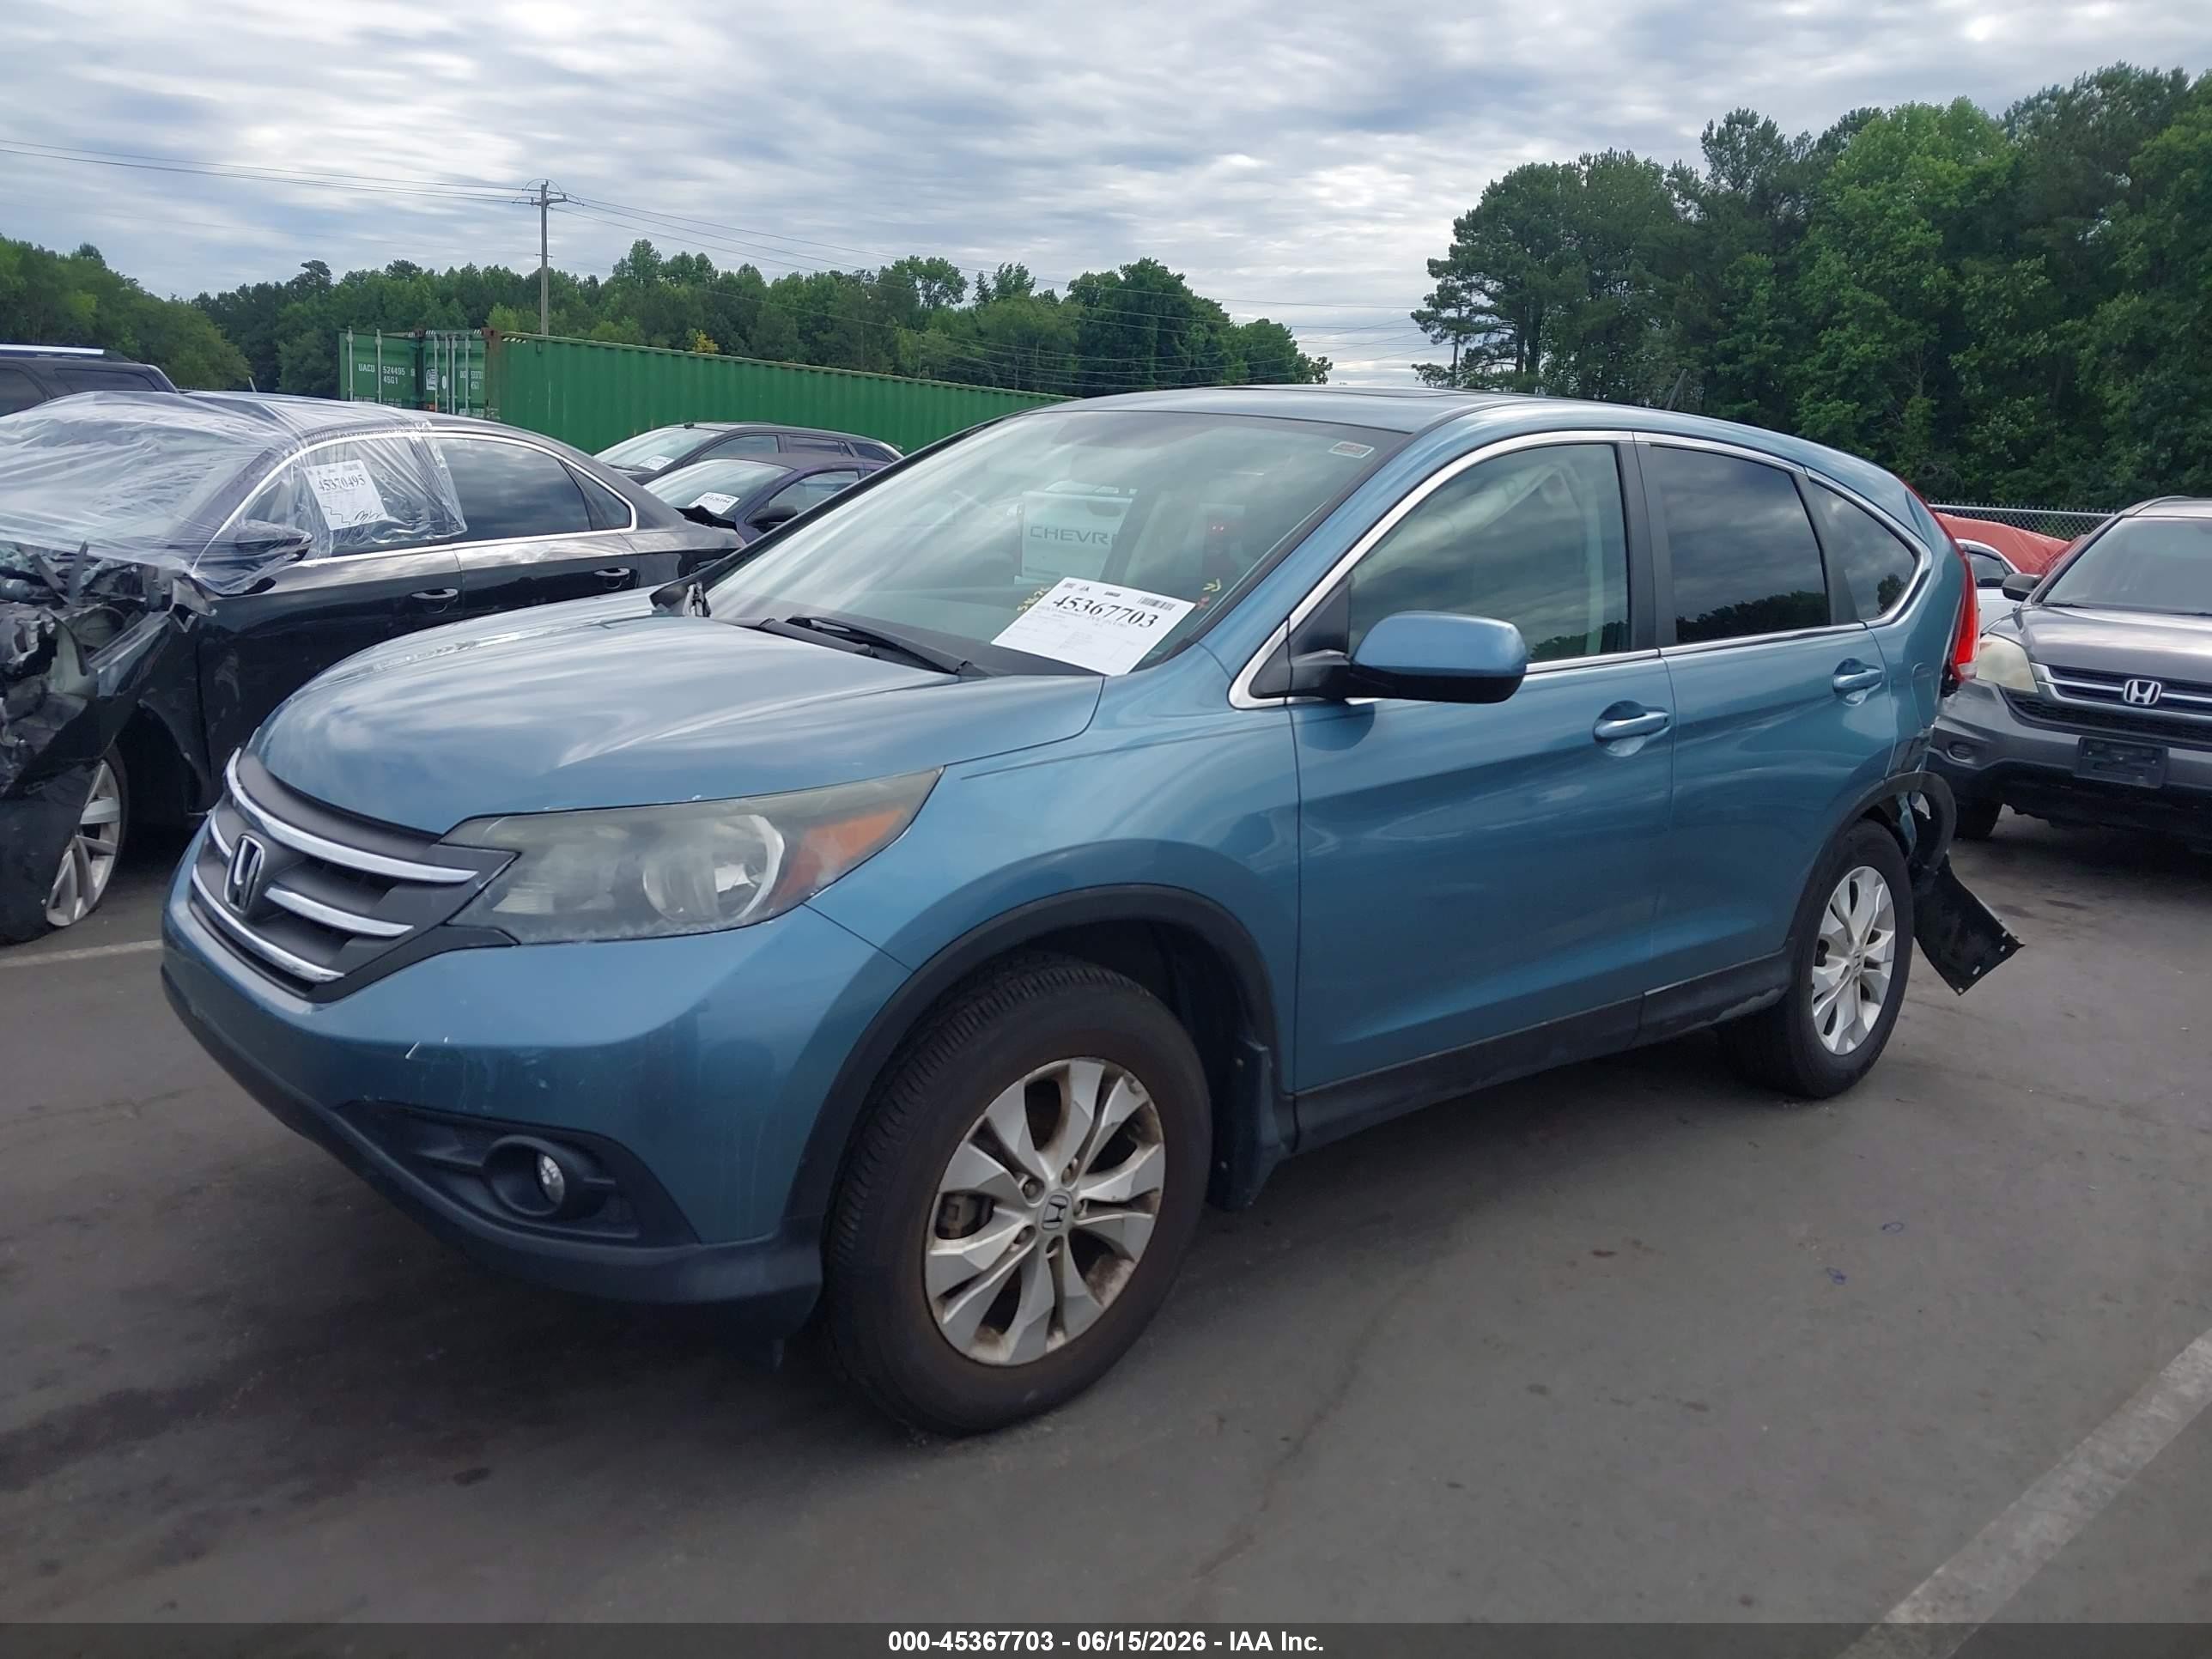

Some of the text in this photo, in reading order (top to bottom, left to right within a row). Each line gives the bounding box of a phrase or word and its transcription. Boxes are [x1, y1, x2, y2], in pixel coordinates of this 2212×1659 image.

[358, 363, 375, 373] UACU
[383, 376, 398, 385] 45G1
[319, 475, 366, 491] 45370495
[1053, 595, 1159, 629] 45367703
